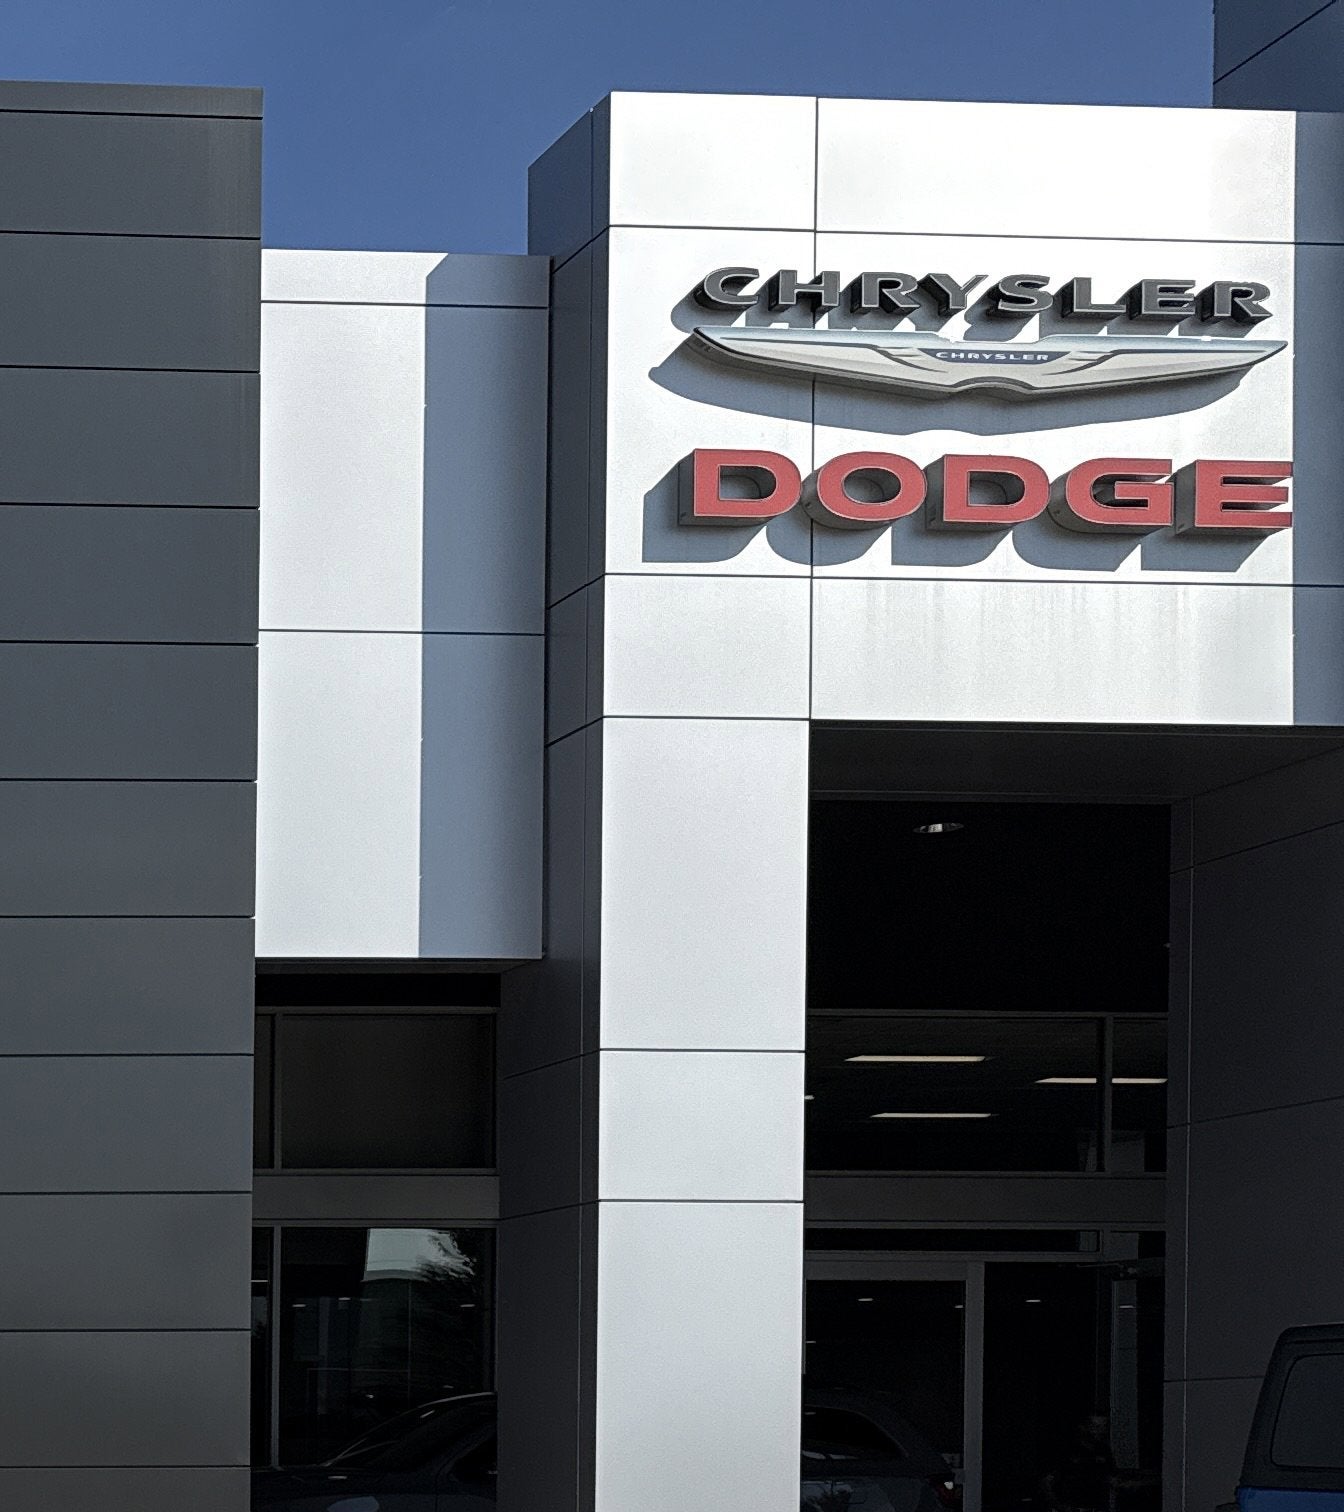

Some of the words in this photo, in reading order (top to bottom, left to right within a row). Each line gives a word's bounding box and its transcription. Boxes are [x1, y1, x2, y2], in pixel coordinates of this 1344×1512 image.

[698, 266, 1272, 320] CHRYSLER
[935, 351, 1049, 361] CHRYSLER
[688, 448, 1294, 532] DODGE
